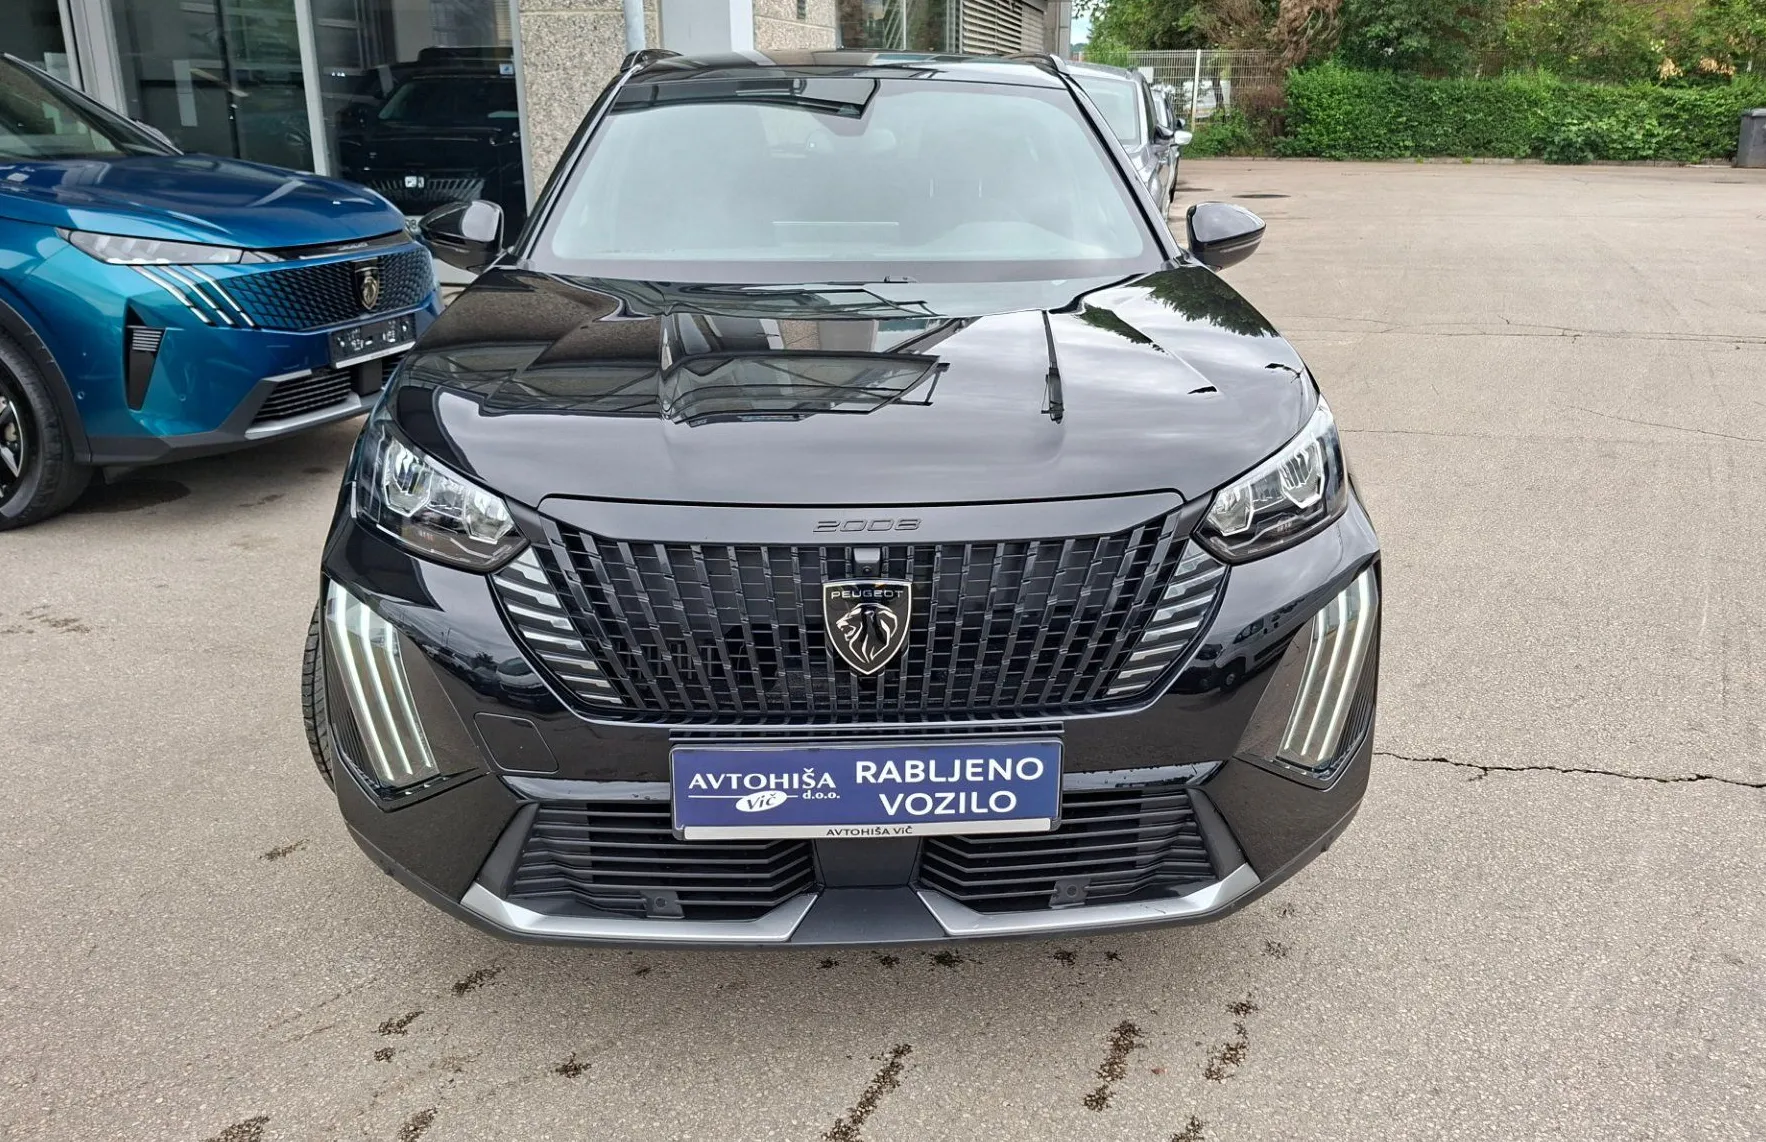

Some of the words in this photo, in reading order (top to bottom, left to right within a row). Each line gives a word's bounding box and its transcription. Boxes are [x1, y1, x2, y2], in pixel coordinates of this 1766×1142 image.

[813, 519, 922, 532] 2008
[830, 589, 904, 599] PEUGEOT
[688, 767, 837, 790] AVTOHIŠA
[855, 757, 1044, 783] RABLJENO
[746, 792, 777, 810] Vič
[802, 789, 841, 799] d.o.o.
[879, 790, 1016, 816] VOZILO
[826, 826, 890, 836] AVTOHIŠA
